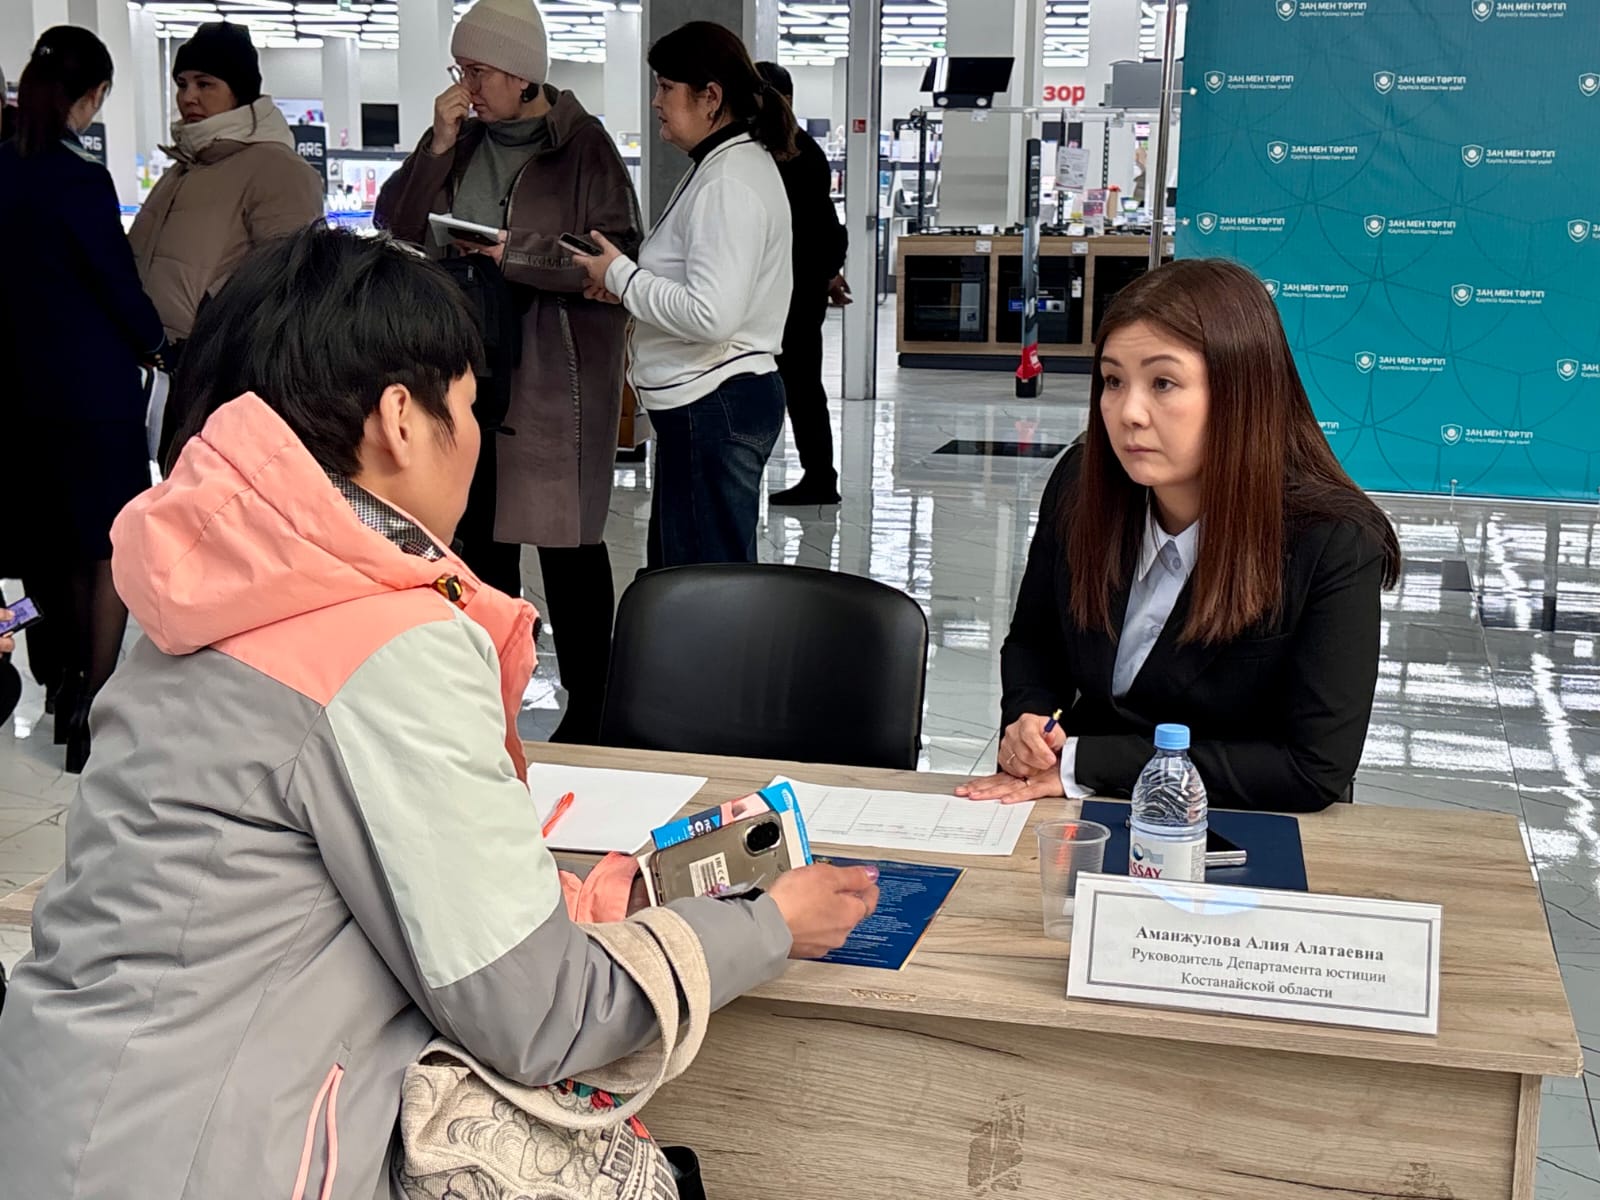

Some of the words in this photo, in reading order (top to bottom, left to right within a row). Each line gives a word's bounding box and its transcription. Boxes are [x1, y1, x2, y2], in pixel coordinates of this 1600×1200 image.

[1317, 2, 1336, 10] МЕН
[1515, 2, 1534, 10] МЕН
[1415, 75, 1436, 84] МЕН
[1308, 145, 1328, 153] МЕН
[1504, 149, 1524, 157] МЕН
[1236, 216, 1256, 225] МЕН
[1406, 220, 1426, 228] МЕН
[1299, 284, 1318, 292] МЕН
[1493, 289, 1514, 297] МЕН
[1396, 356, 1416, 365] МЕН
[1482, 429, 1502, 437] МЕН
[1135, 926, 1241, 948] Аманжулова
[1245, 936, 1289, 953] Алия
[1294, 941, 1384, 961] Алатаевна
[1131, 947, 1223, 968] Руководитель
[1226, 956, 1322, 977] Департамента
[1326, 968, 1386, 984] юстиции
[1181, 972, 1275, 993] Костанайской
[1279, 984, 1333, 999] области
